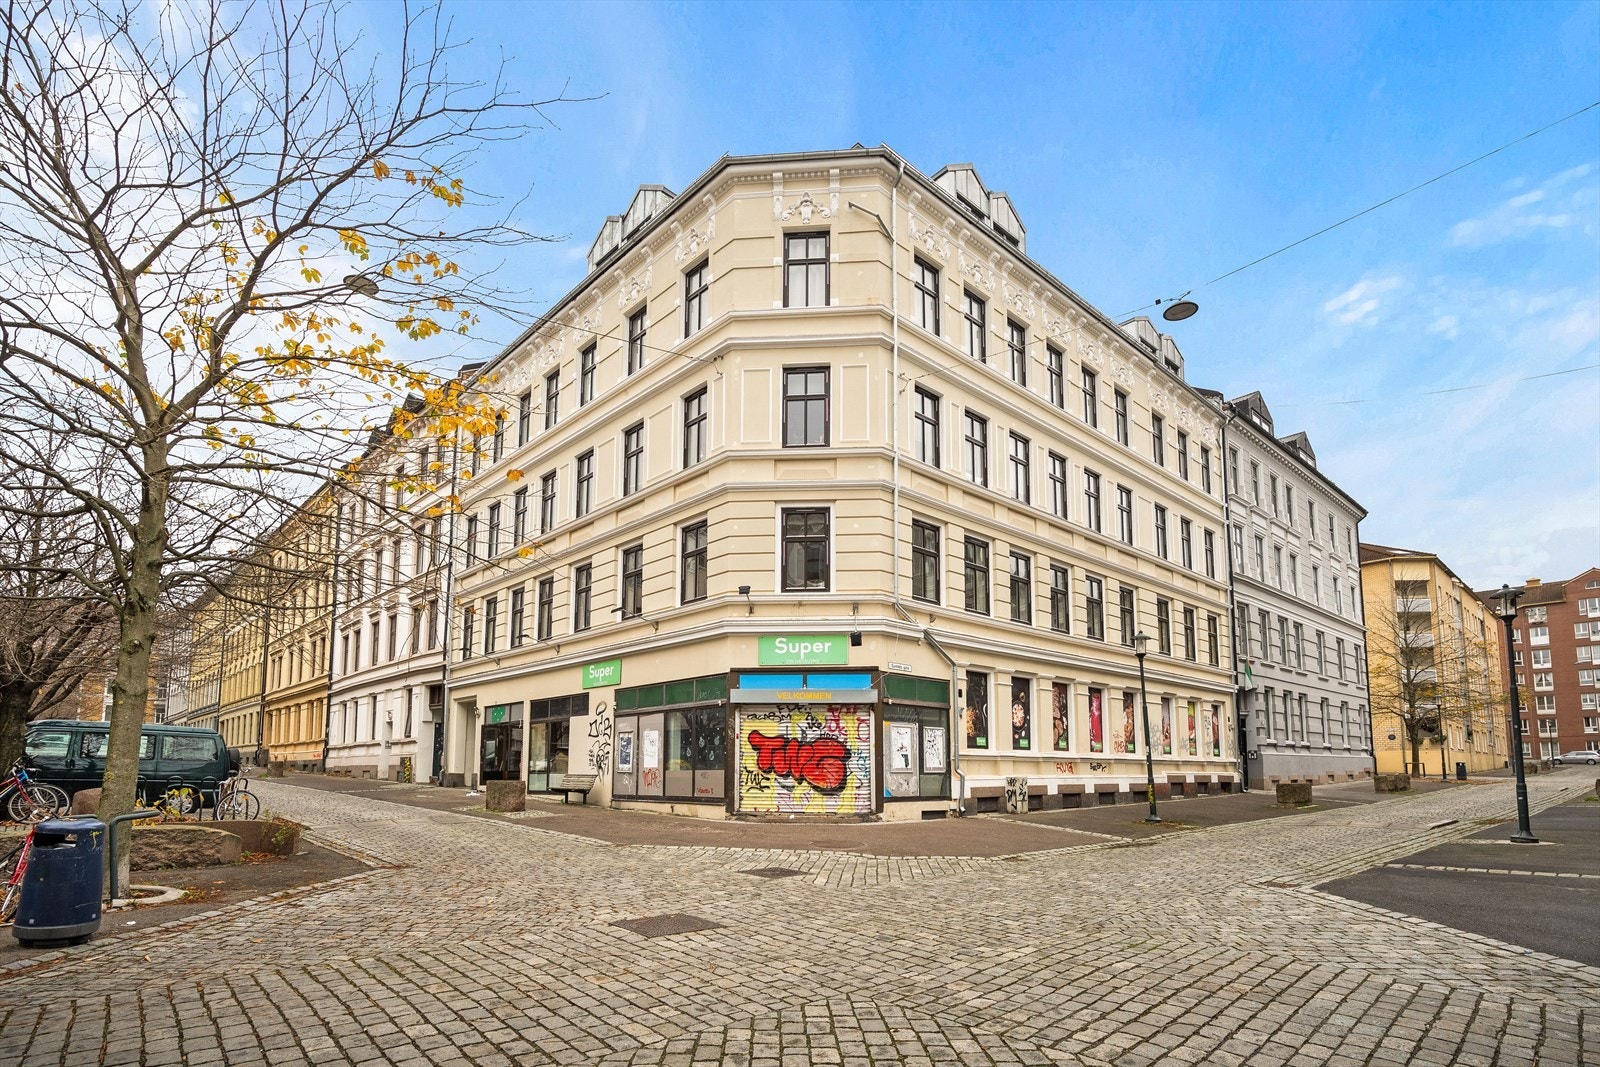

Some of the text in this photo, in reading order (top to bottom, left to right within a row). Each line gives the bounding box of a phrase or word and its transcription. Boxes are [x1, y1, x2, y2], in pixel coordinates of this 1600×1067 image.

[774, 637, 831, 659] Super
[588, 665, 614, 682] Super
[776, 691, 832, 700] VELKOMMEN
